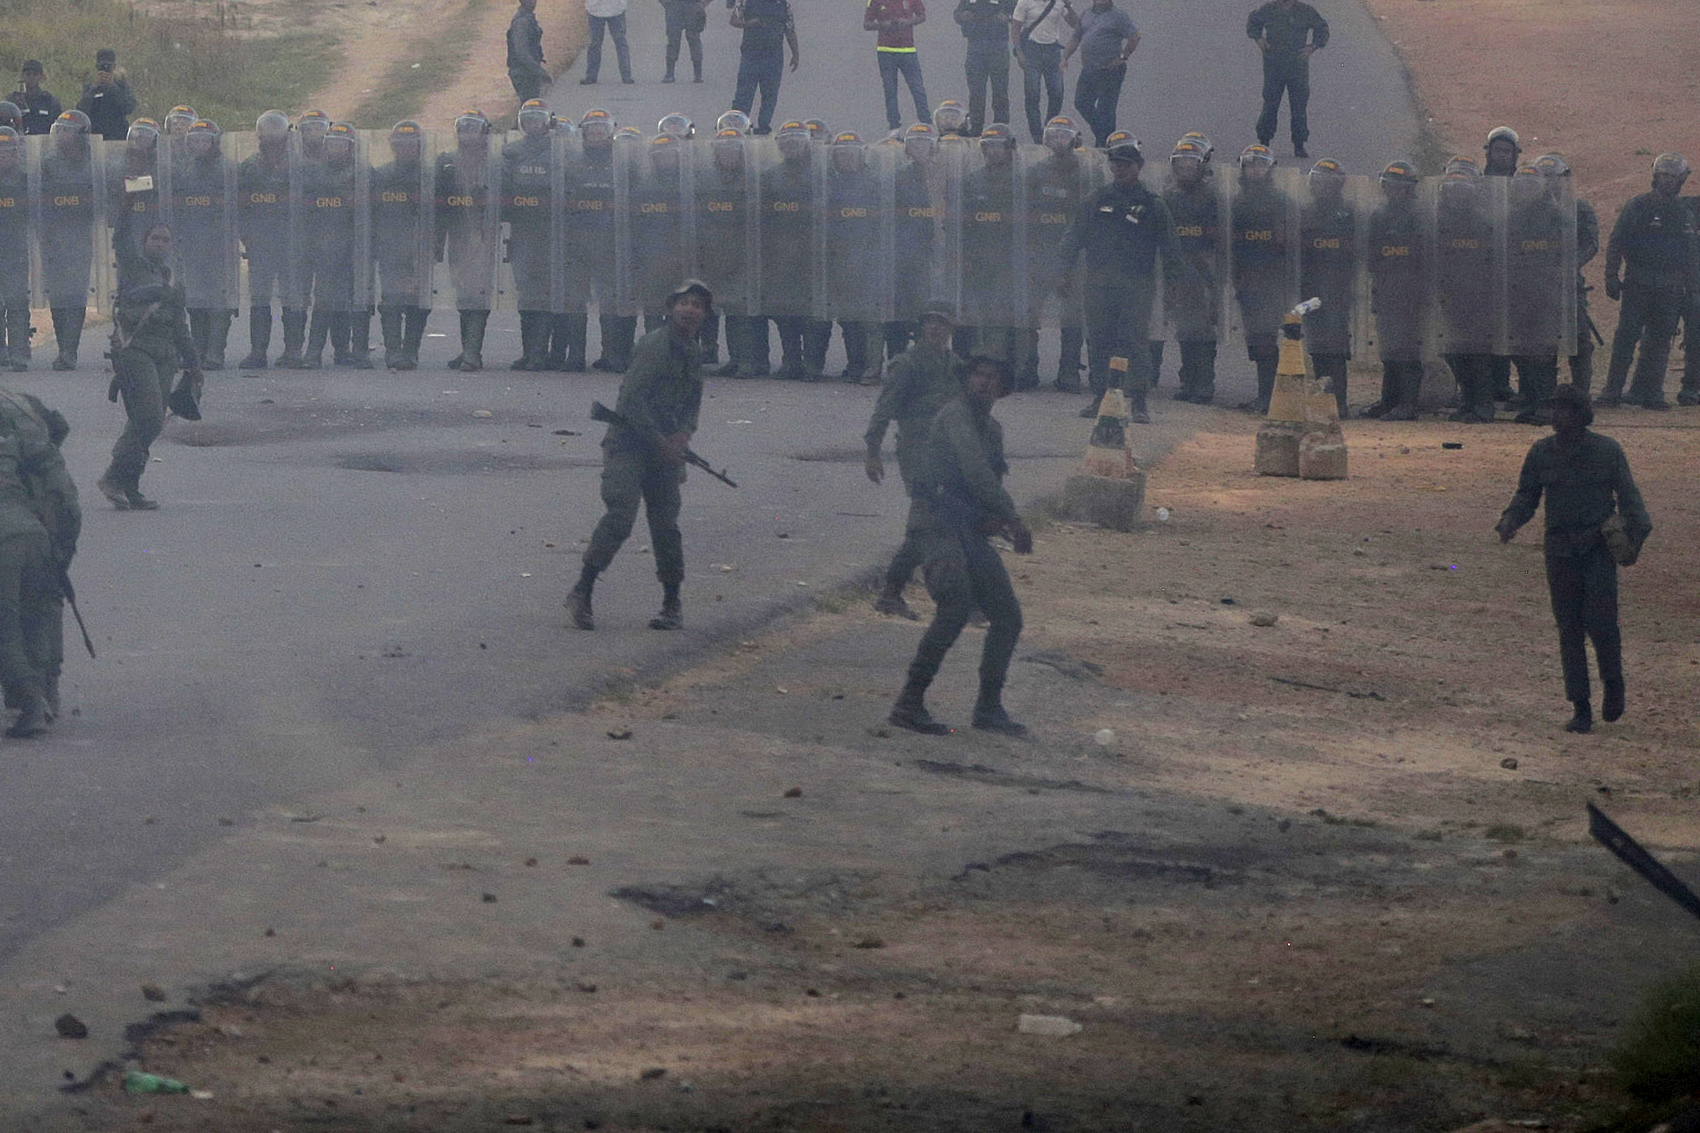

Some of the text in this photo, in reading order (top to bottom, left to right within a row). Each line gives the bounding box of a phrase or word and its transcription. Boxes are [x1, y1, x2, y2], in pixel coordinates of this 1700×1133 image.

[54, 196, 79, 206] GNB
[186, 196, 210, 206] GNB
[251, 193, 276, 203] GNB
[316, 197, 341, 208] GNB
[382, 192, 407, 202] GNB
[447, 196, 474, 206] GNB
[513, 196, 539, 206] GNB
[578, 200, 603, 210] GNB
[641, 202, 668, 213] GNB
[708, 201, 733, 211] GNB
[773, 201, 799, 212] GNB
[840, 207, 867, 218] GNB
[908, 207, 935, 218] GNB
[975, 212, 1001, 223] GNB
[1041, 213, 1067, 224] GNB
[1176, 226, 1203, 237] GNB
[1245, 230, 1272, 241] GNB
[1313, 238, 1340, 249] GNB
[1452, 239, 1480, 249] GNB
[1521, 240, 1549, 250] GNB
[1381, 246, 1409, 257] GNB
